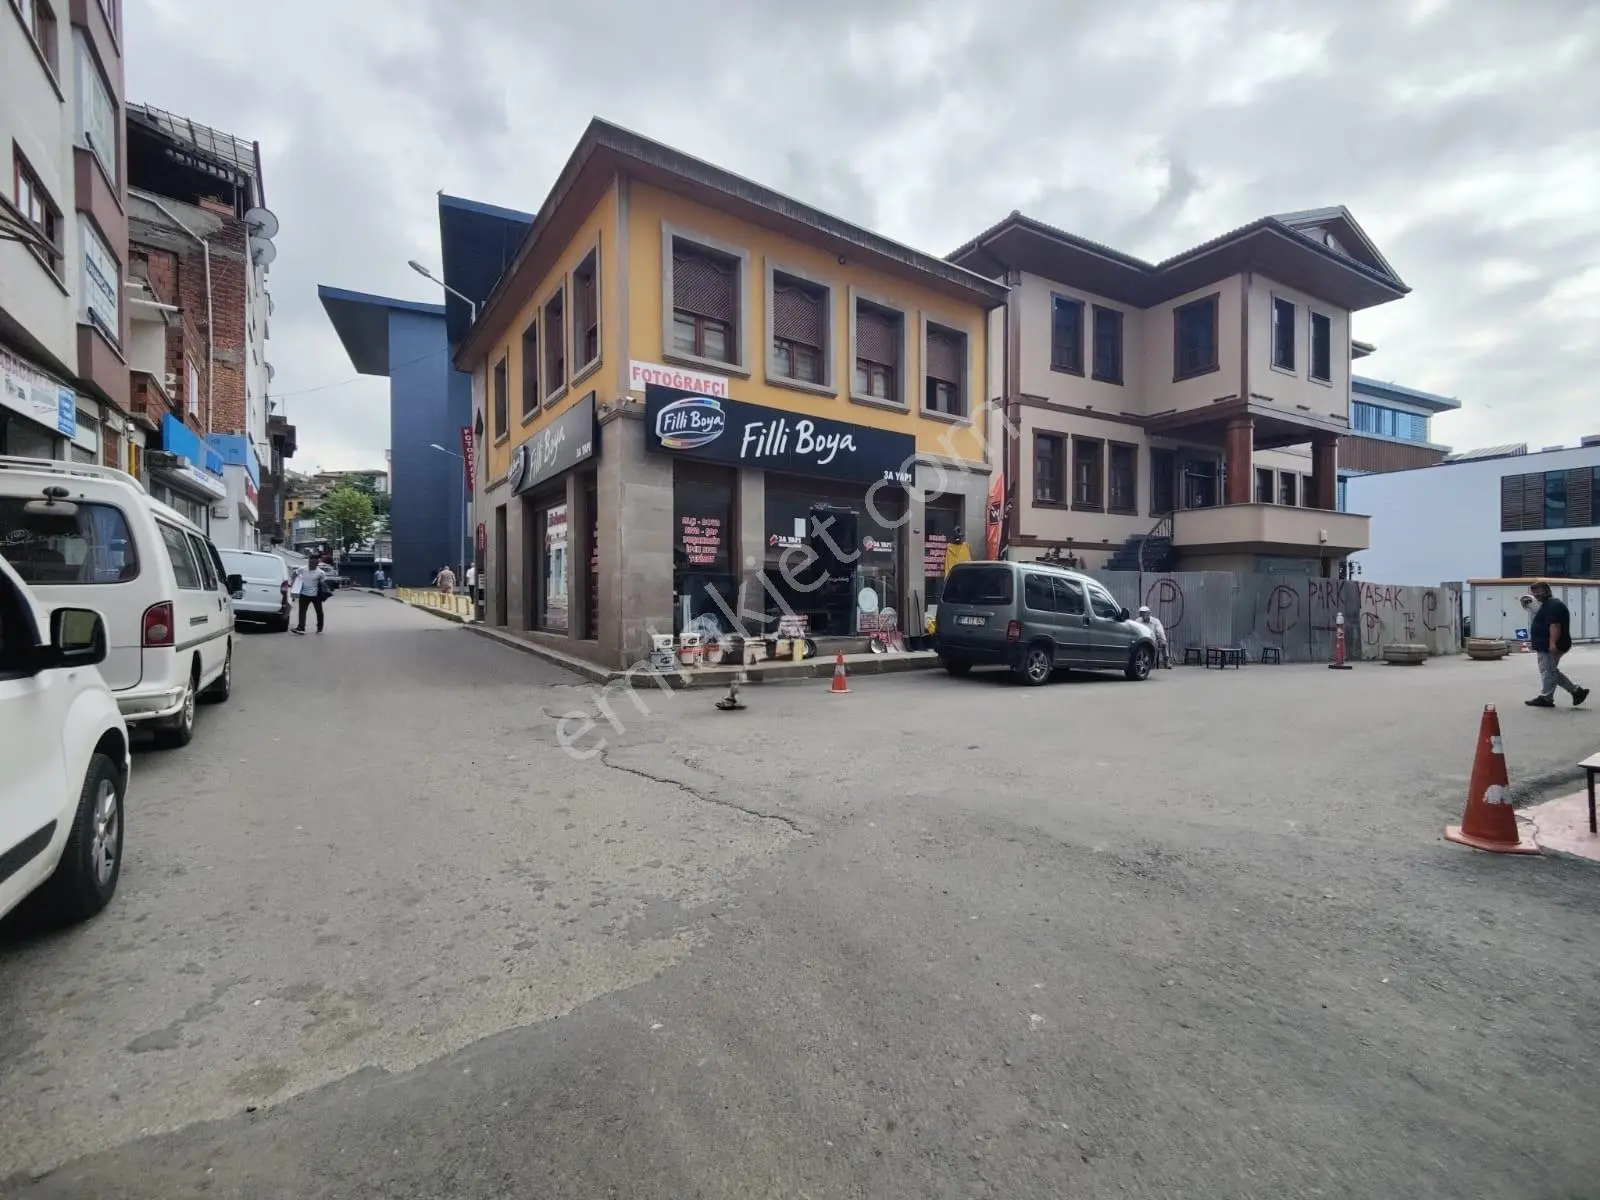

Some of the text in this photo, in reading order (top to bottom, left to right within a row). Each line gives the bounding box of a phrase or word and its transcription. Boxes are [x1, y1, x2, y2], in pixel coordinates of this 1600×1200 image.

[632, 366, 725, 398] FOTOĞRAFÇI
[663, 410, 724, 432] Filli Boya
[740, 418, 857, 465] Filli Boya
[1308, 579, 1404, 610] PARK YASAK
